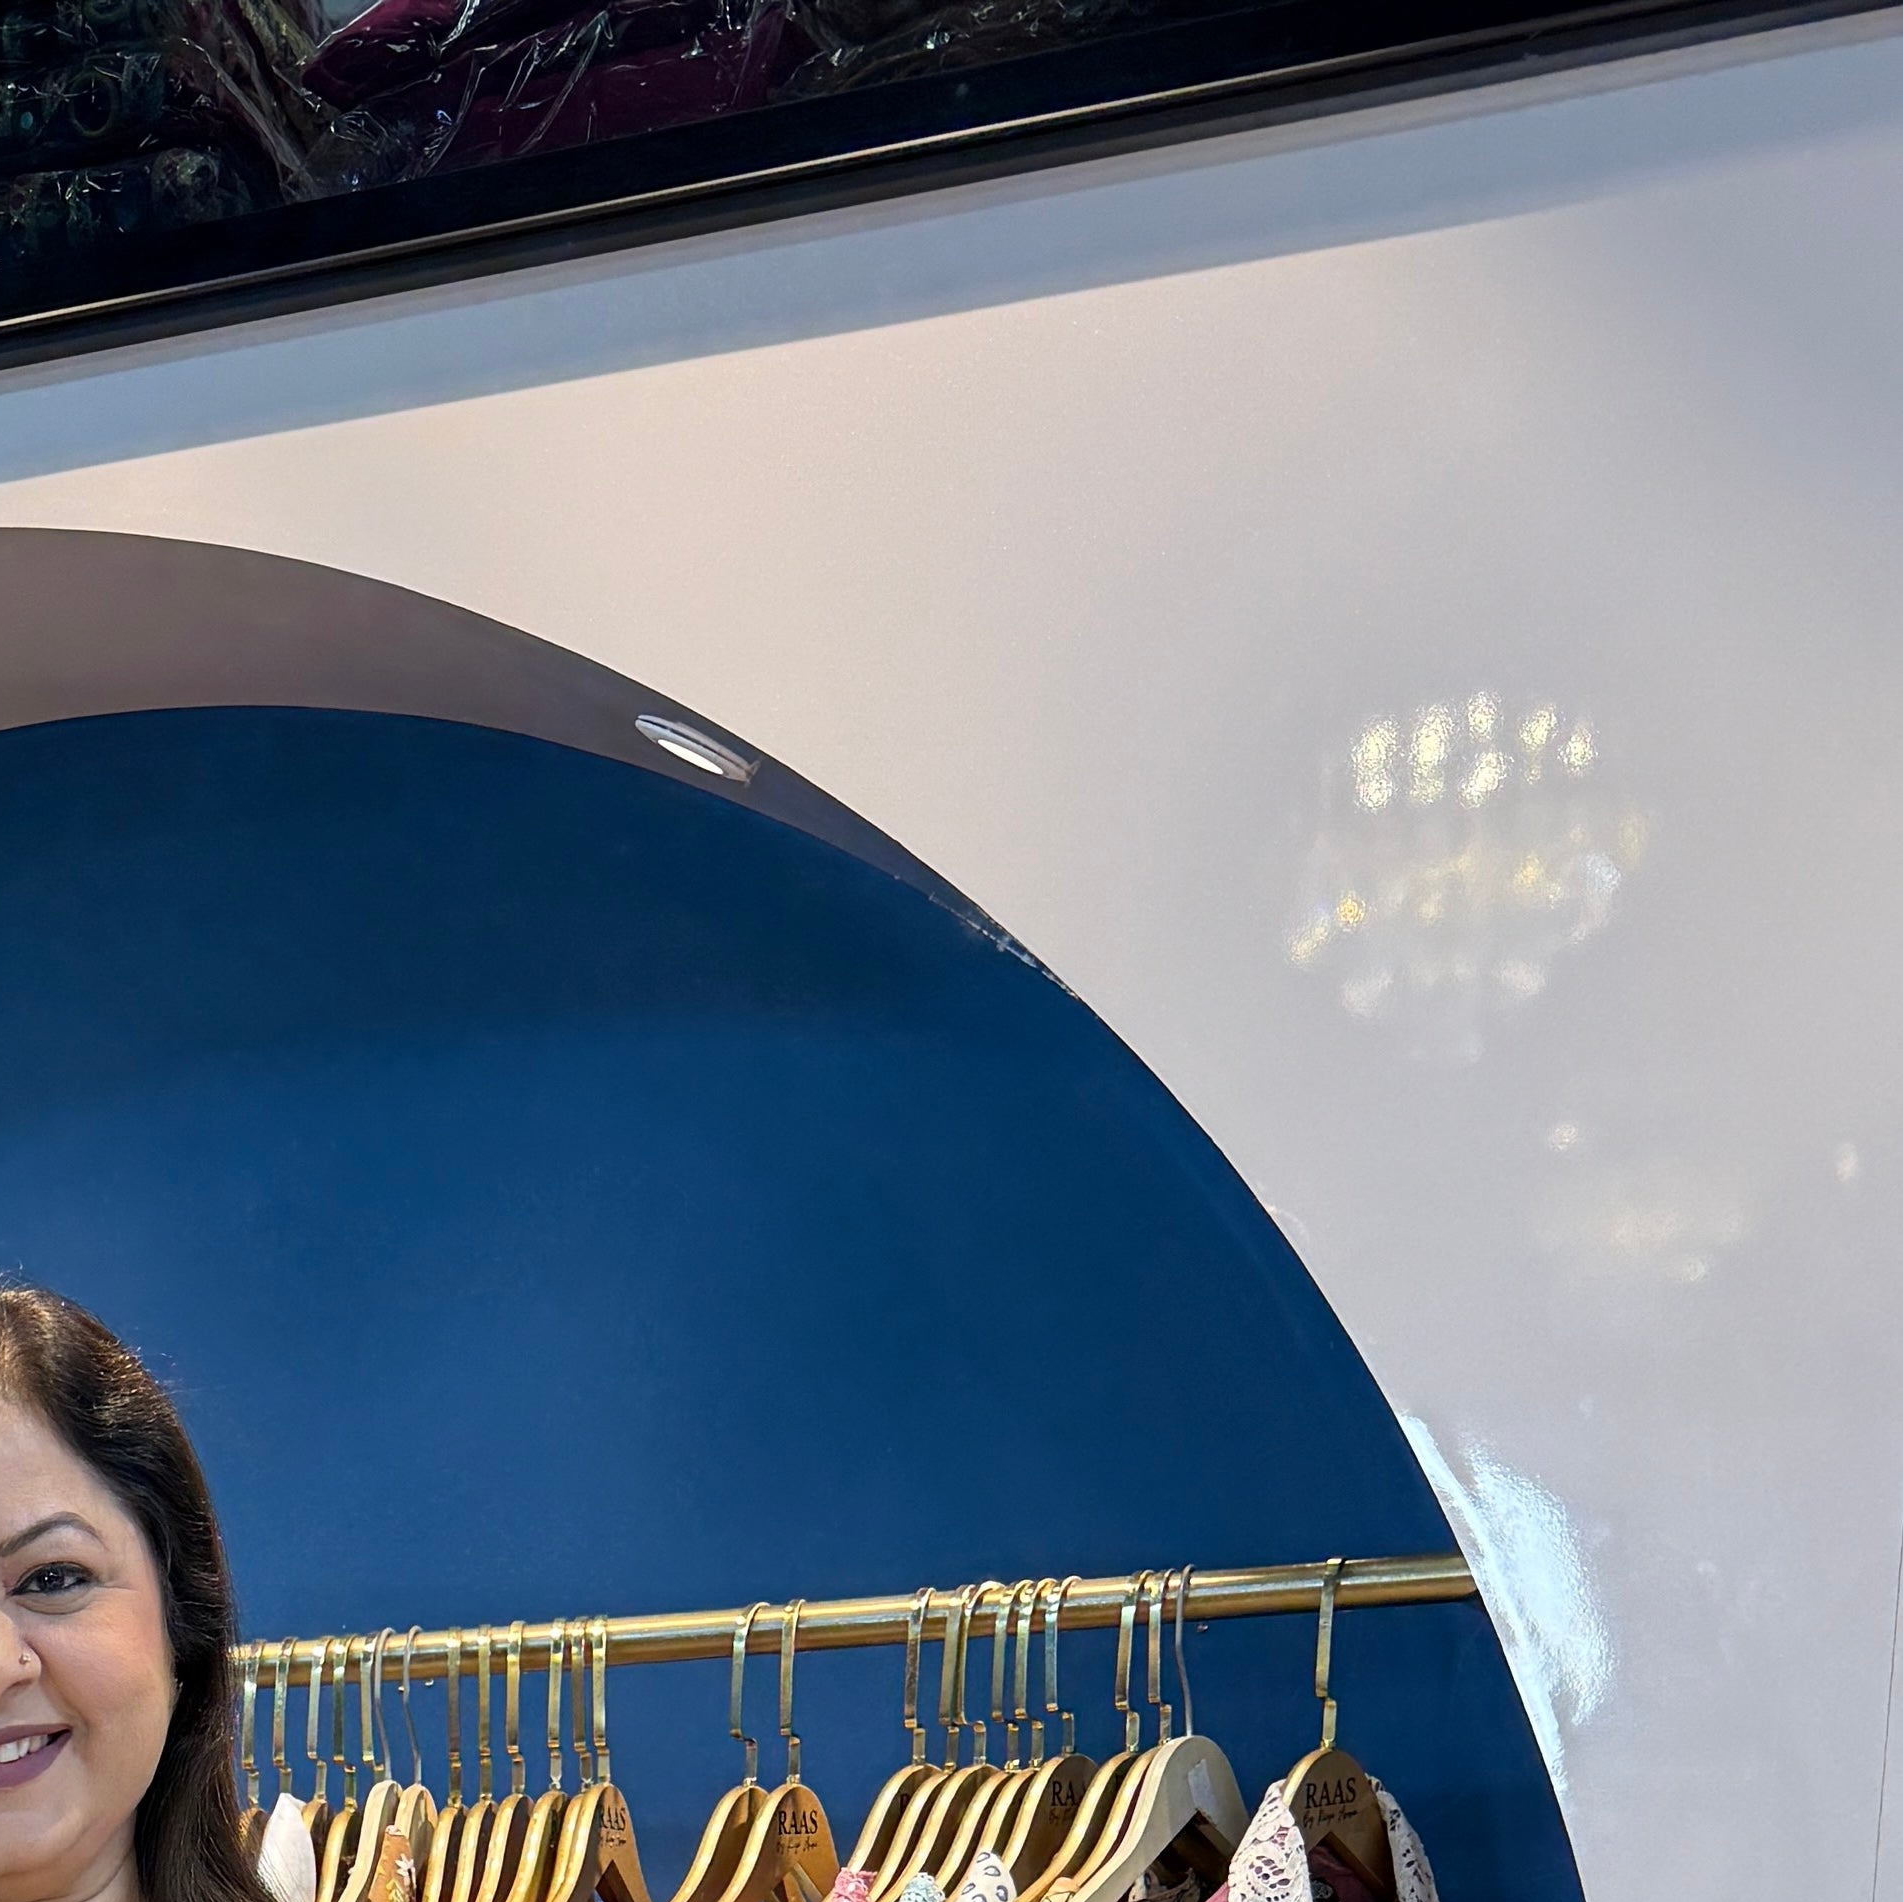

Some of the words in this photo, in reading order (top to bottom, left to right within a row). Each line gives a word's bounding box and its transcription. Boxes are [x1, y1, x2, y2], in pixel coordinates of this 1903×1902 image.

[1051, 1780, 1087, 1807] RA
[1305, 1777, 1357, 1809] RAAS
[778, 1809, 818, 1835] RAAS
